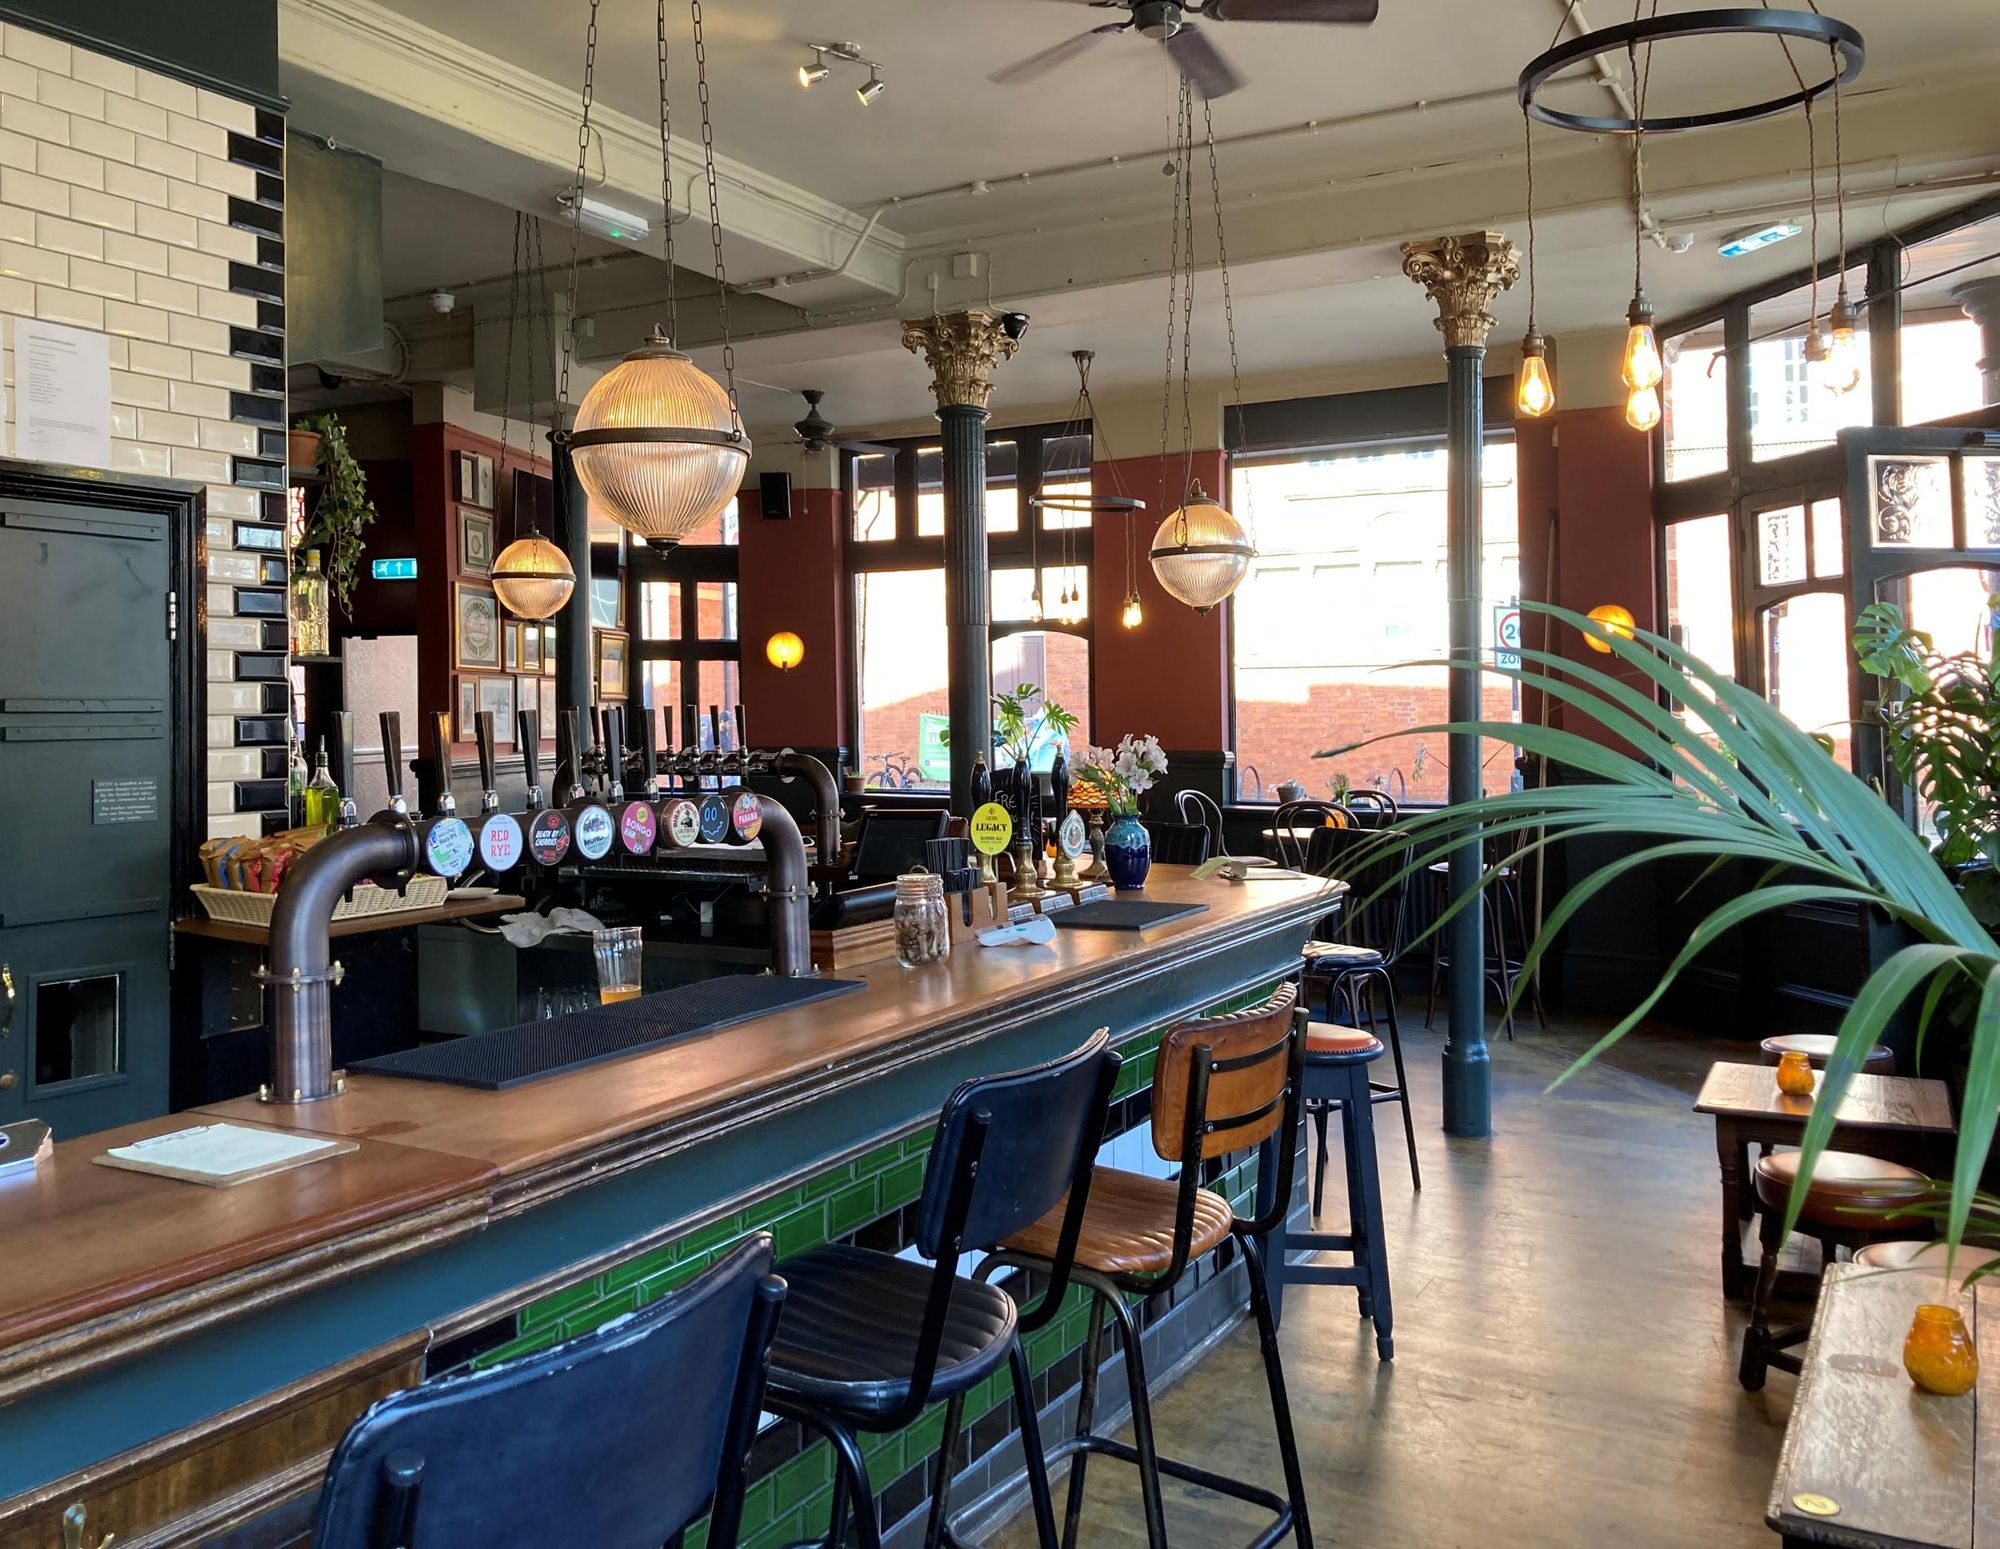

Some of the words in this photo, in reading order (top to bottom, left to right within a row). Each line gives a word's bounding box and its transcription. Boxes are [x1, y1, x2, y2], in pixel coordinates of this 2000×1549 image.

[993, 790, 1017, 809] FRE
[535, 830, 551, 838] DEATH
[626, 817, 652, 838] BONGO
[976, 823, 1007, 832] LEGACY
[491, 829, 509, 842] RED
[491, 844, 510, 857] RYE
